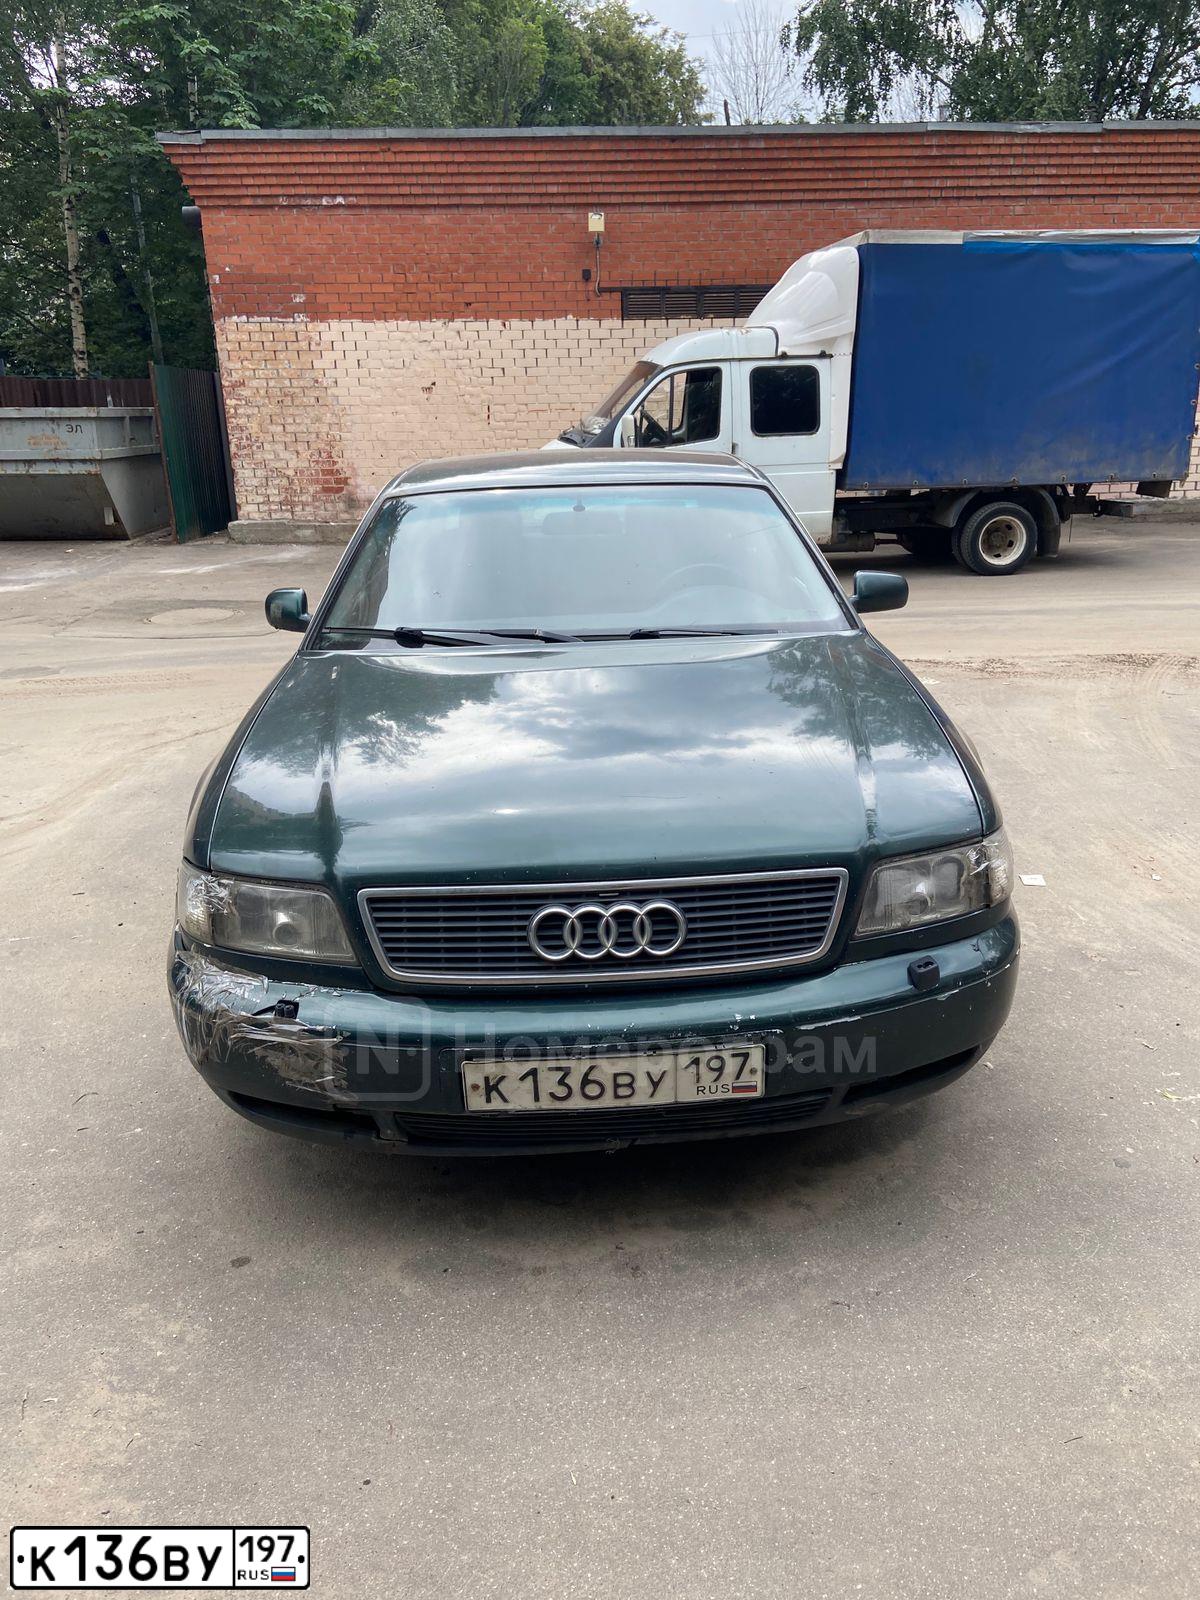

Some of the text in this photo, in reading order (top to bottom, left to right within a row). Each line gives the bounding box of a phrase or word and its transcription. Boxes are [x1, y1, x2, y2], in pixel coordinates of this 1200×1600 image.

[483, 1052, 751, 1104] К136ВУ 197
[696, 1083, 731, 1096] RUS
